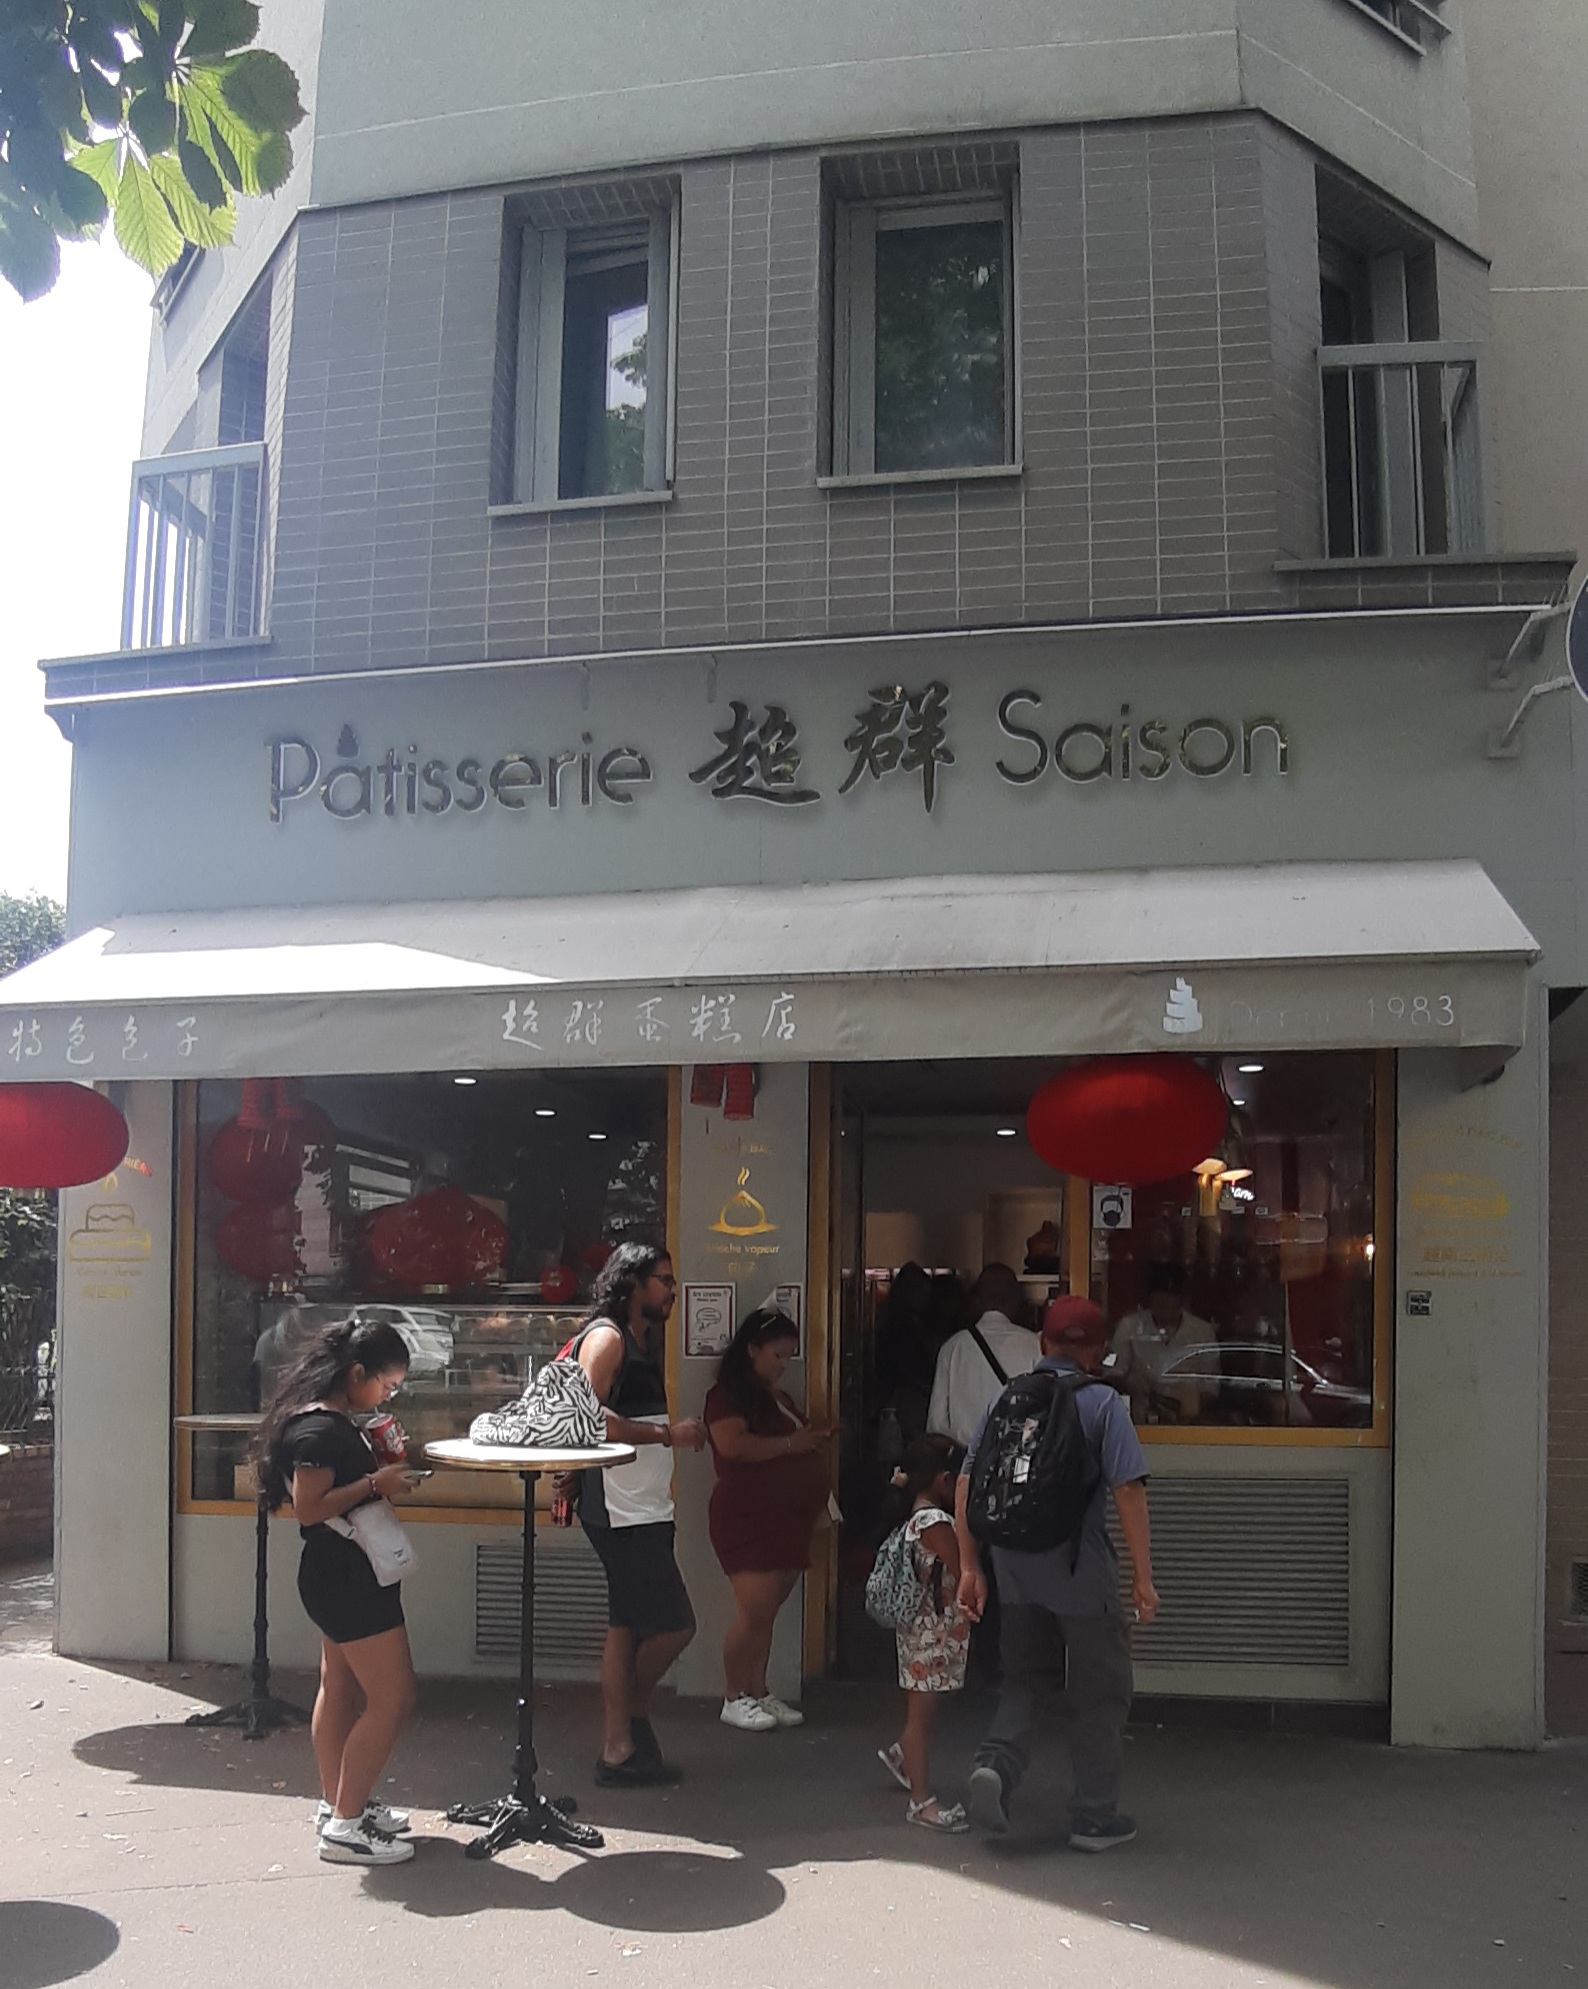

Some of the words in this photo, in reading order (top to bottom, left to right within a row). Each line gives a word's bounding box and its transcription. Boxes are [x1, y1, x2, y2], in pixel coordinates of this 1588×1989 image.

[688, 681, 956, 813] 超群
[995, 689, 1288, 786] Saison
[501, 991, 796, 1050] 超群蛋糕店
[1367, 995, 1455, 1027] 1983
[745, 1244, 780, 1256] vapeur
